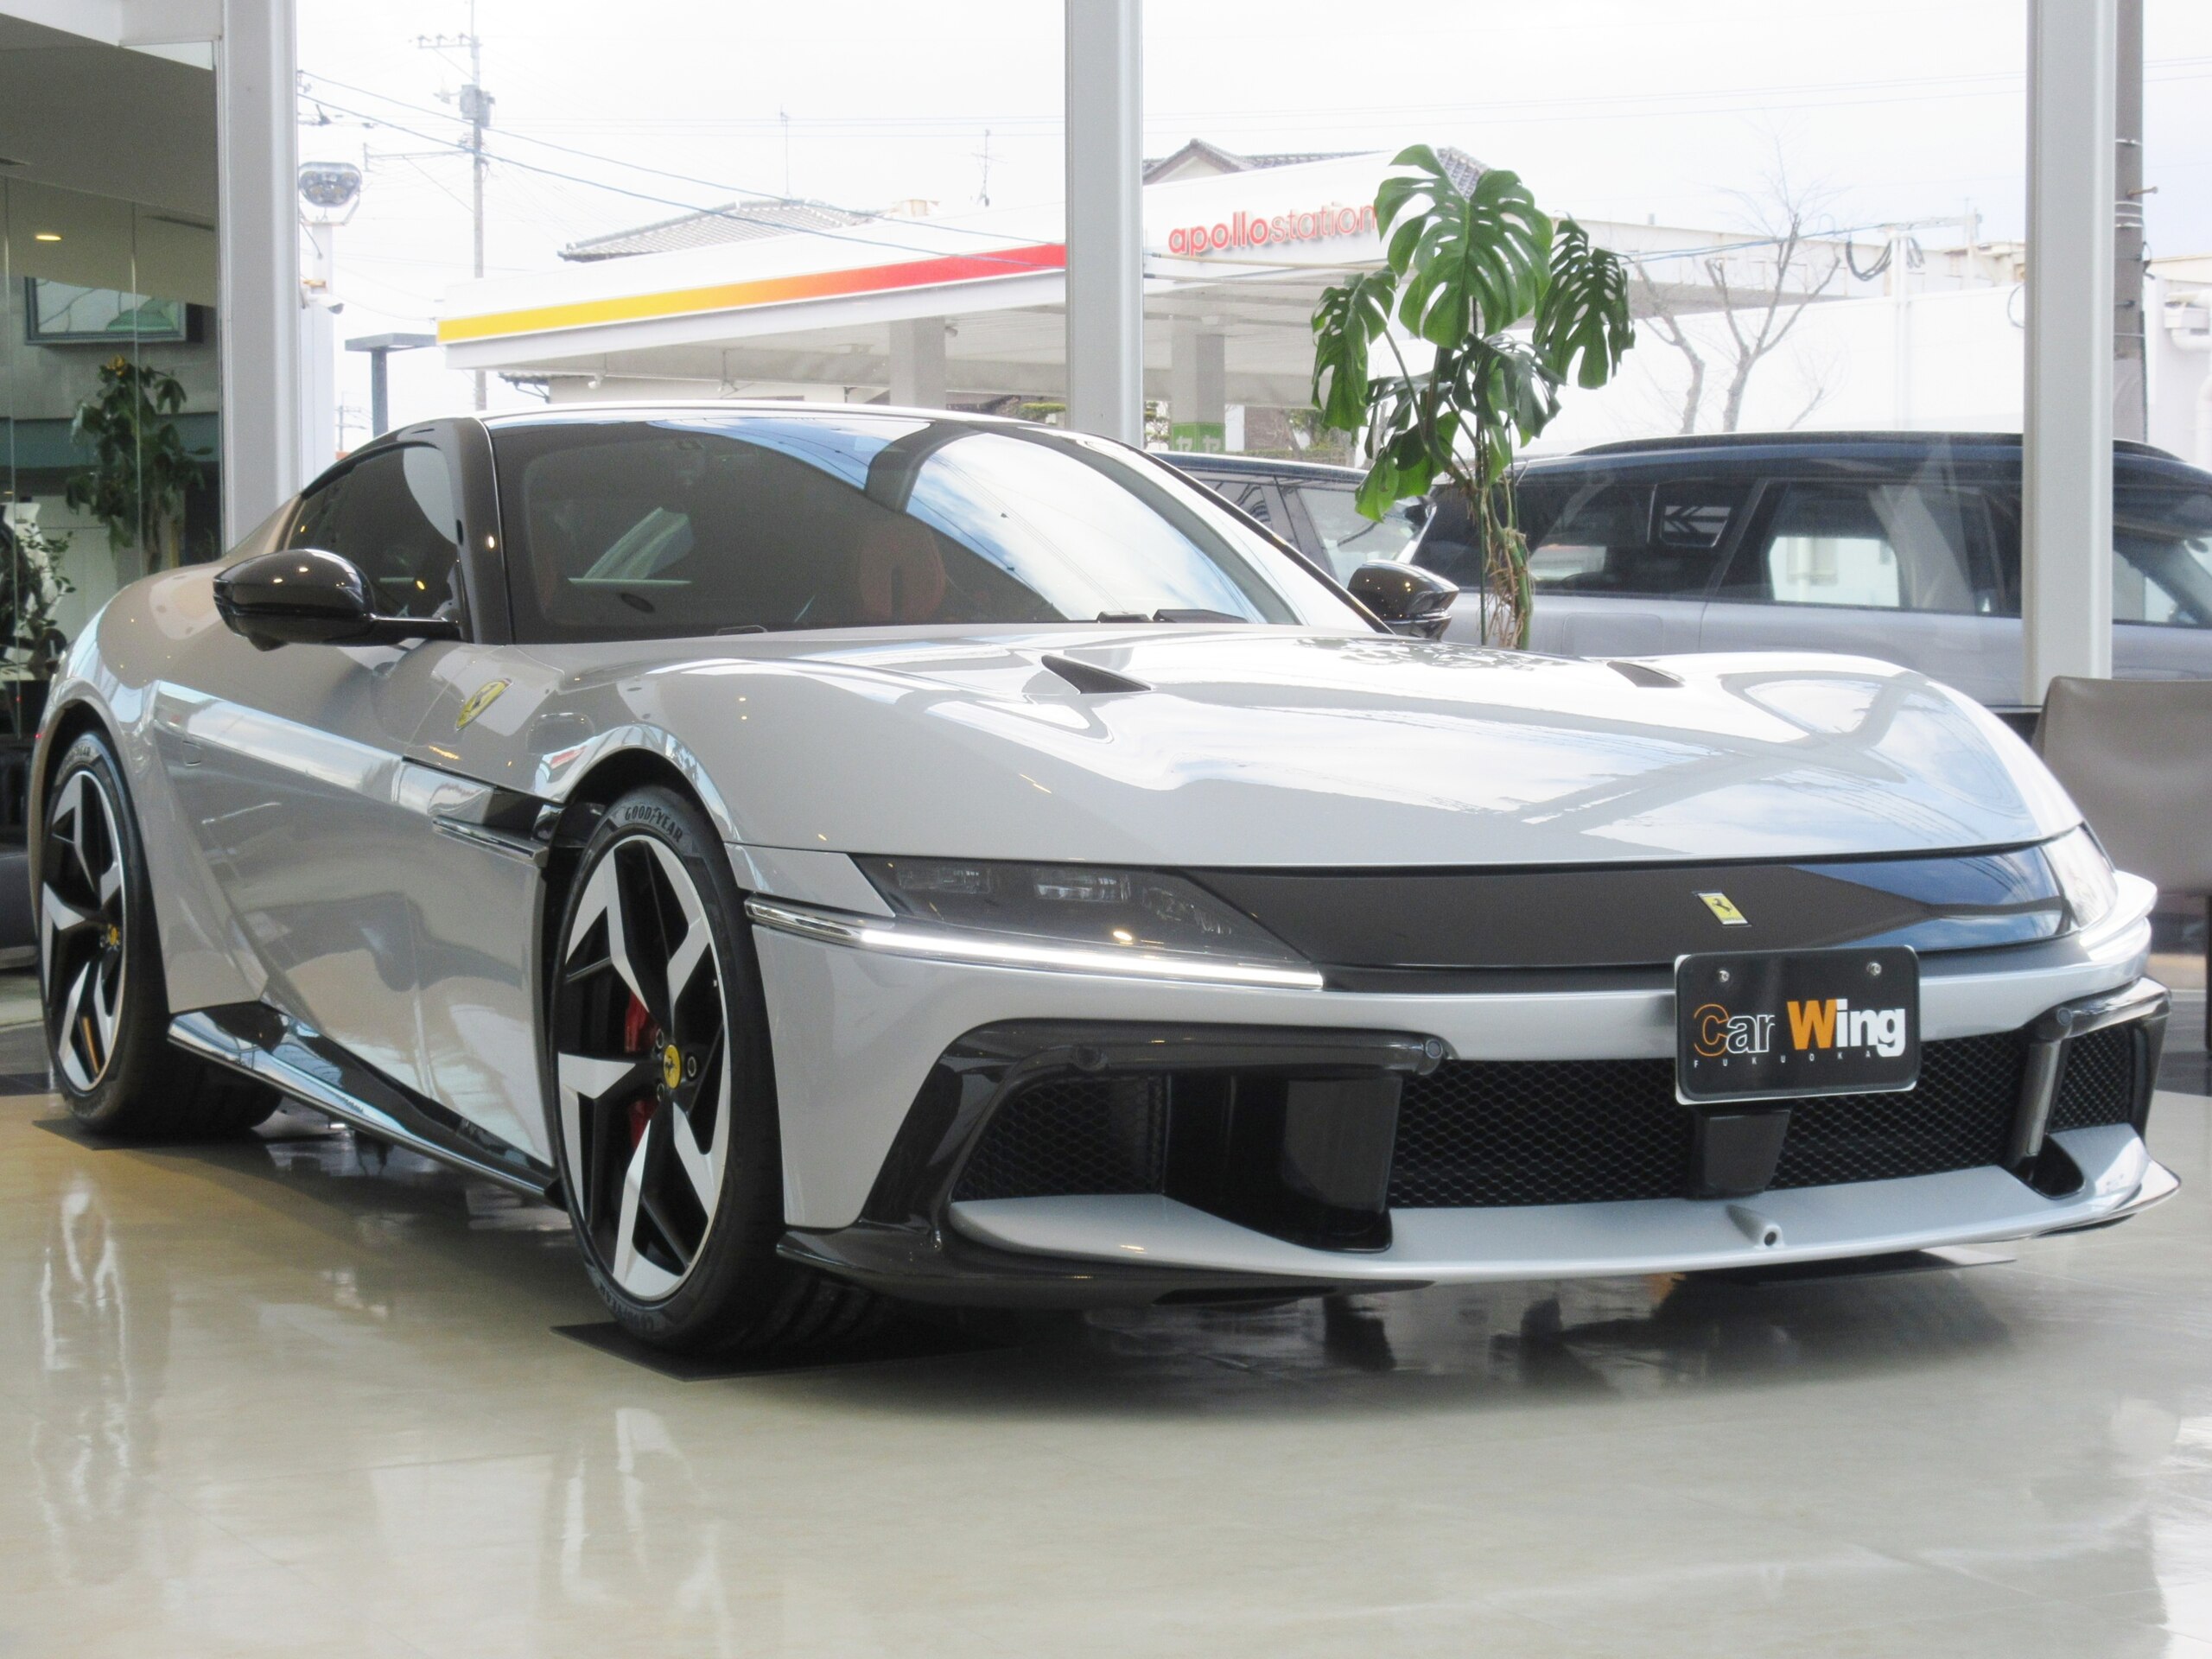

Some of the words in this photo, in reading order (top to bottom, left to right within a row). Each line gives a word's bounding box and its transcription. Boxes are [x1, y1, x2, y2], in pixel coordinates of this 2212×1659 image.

[1168, 202, 1377, 257] apollostation
[624, 804, 683, 843] GOODYEAR
[1694, 1003, 1776, 1057] Car
[1786, 998, 1906, 1058] Wing
[1694, 1052, 1872, 1069] FUKUOKA
